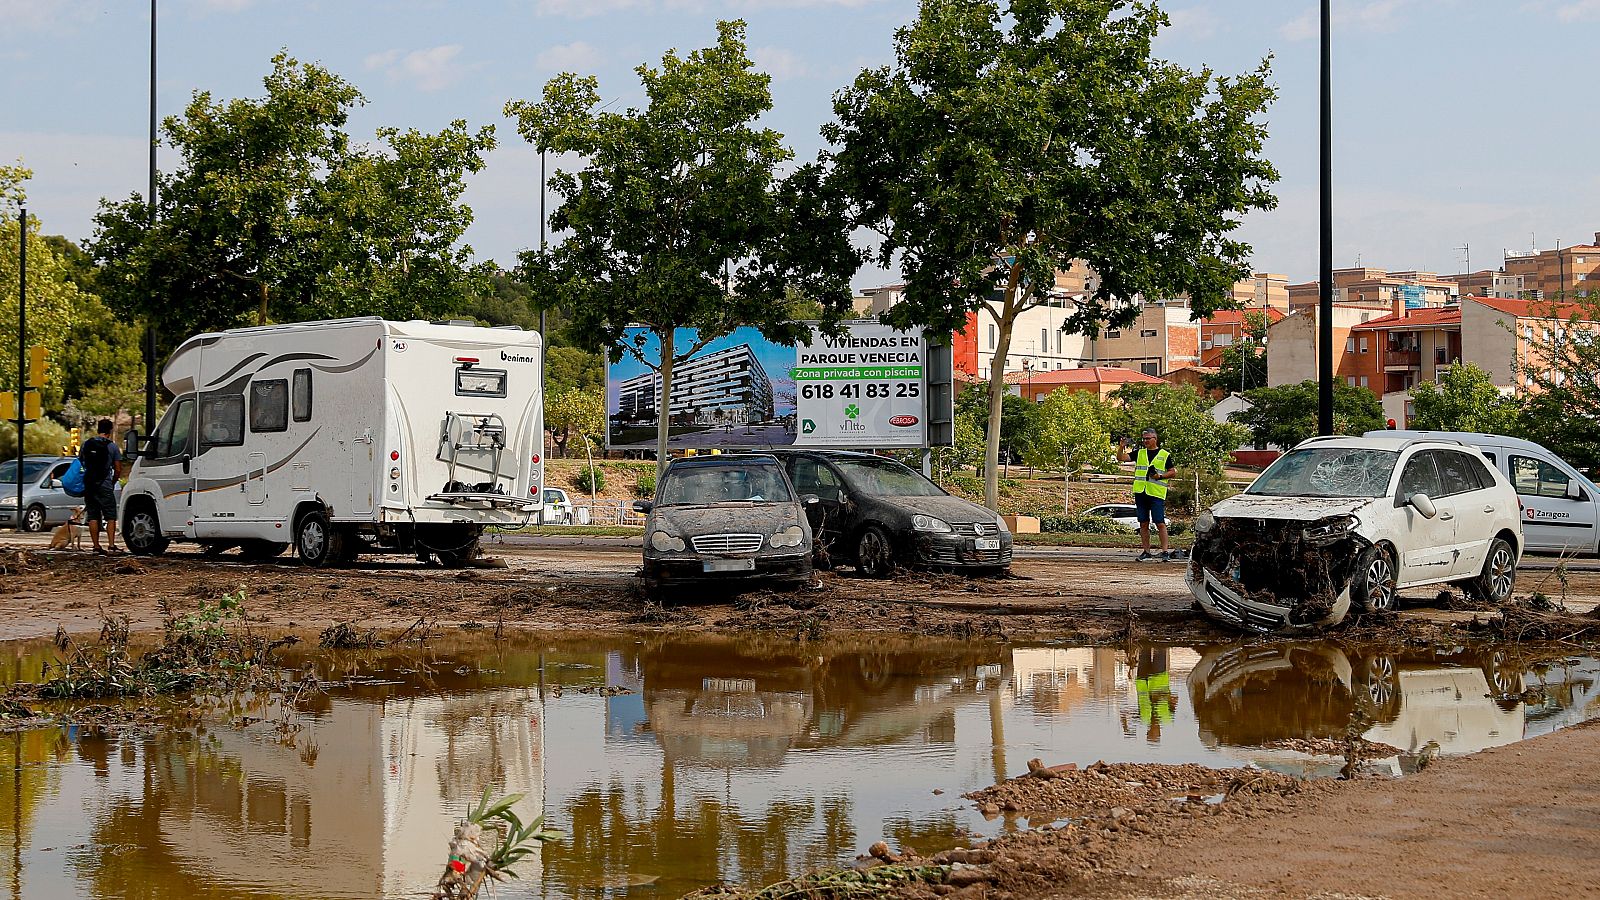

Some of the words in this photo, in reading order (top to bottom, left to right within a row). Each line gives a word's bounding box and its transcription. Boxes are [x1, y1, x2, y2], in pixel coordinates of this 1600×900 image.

[825, 338, 897, 348] VIVIENDAS
[901, 337, 919, 347] EN
[801, 354, 856, 364] PARQUE
[859, 353, 920, 363] VENECIA
[795, 369, 820, 378] Zona
[824, 368, 861, 379] privada
[884, 367, 920, 378] piscina
[801, 384, 834, 399] 618
[839, 383, 860, 399] 41
[865, 383, 890, 398] 83
[895, 382, 920, 398] 25
[1536, 509, 1570, 520] Zaragoza
